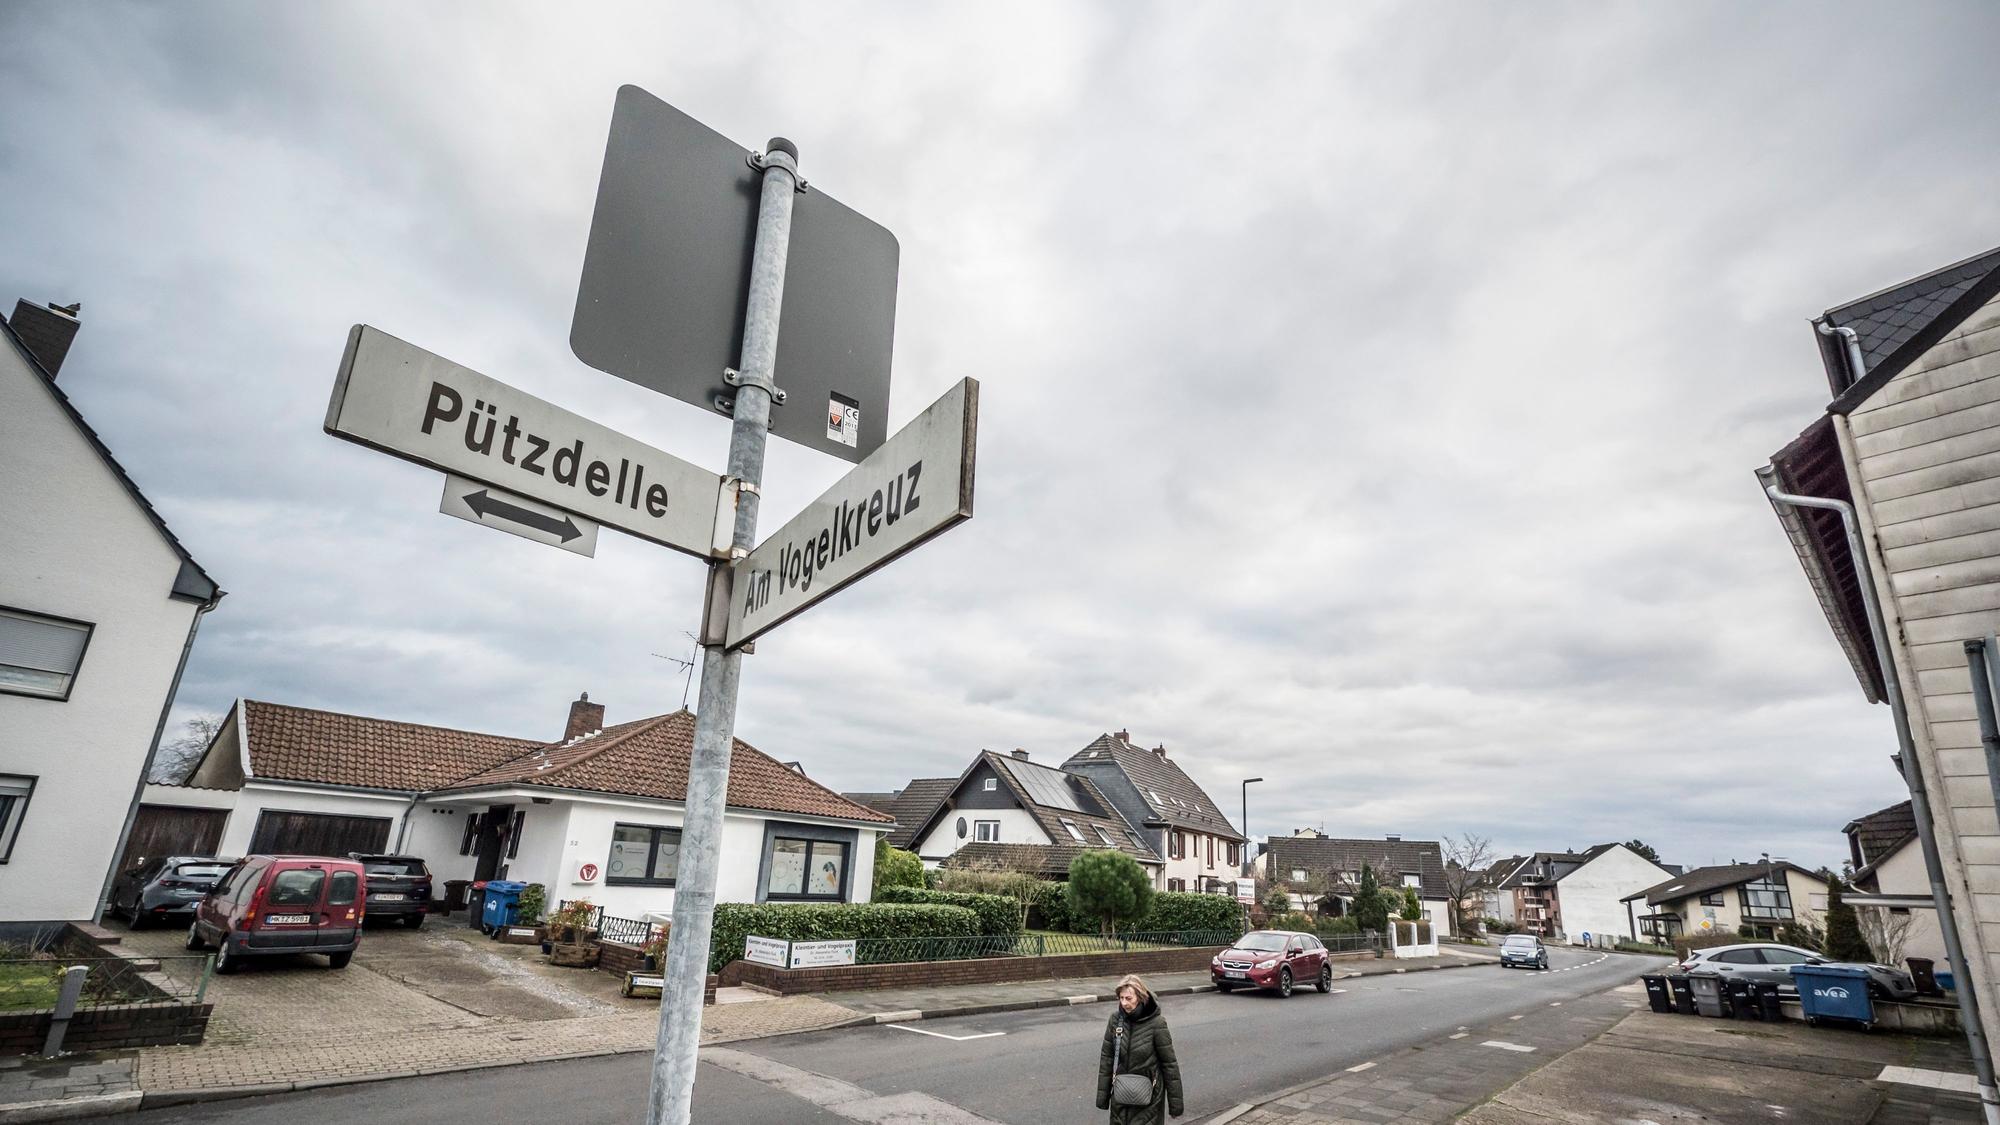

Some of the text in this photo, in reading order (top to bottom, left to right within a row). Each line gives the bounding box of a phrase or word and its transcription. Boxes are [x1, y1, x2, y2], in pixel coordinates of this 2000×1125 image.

[420, 381, 669, 518] Pützdelle
[743, 460, 922, 618] Am Vogelkreuz
[1814, 987, 1849, 998] avea
